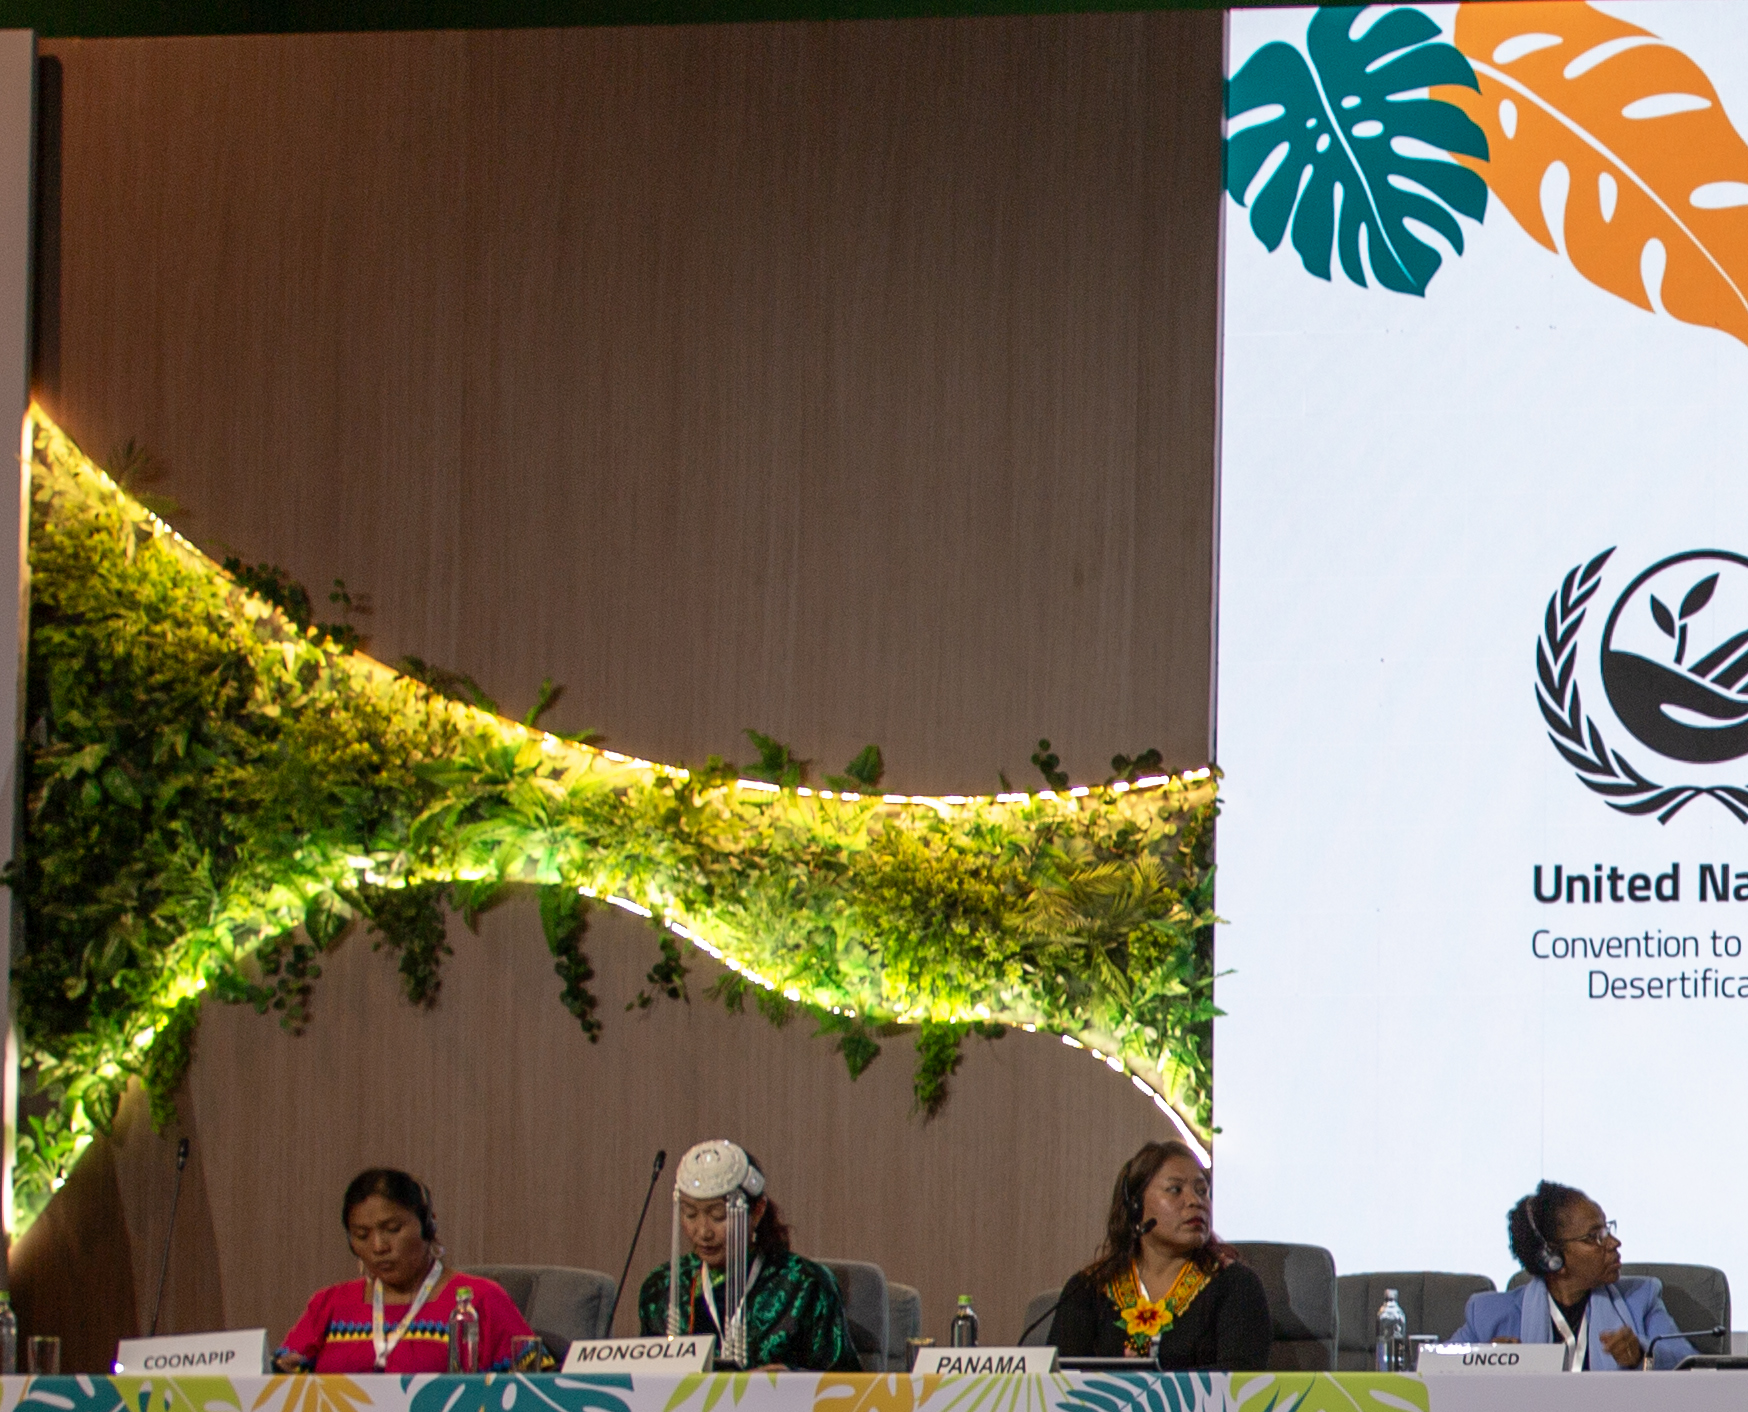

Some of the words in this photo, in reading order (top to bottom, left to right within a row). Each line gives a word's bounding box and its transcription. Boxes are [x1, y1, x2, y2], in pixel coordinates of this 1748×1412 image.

[1534, 862, 1679, 903] United
[1532, 929, 1698, 959] Convention
[1711, 930, 1741, 957] to
[144, 1350, 235, 1369] COONAPIP
[577, 1342, 696, 1361] MONGOLIA
[1463, 1353, 1519, 1365] UNCCD
[936, 1356, 1026, 1373] PANAMA
